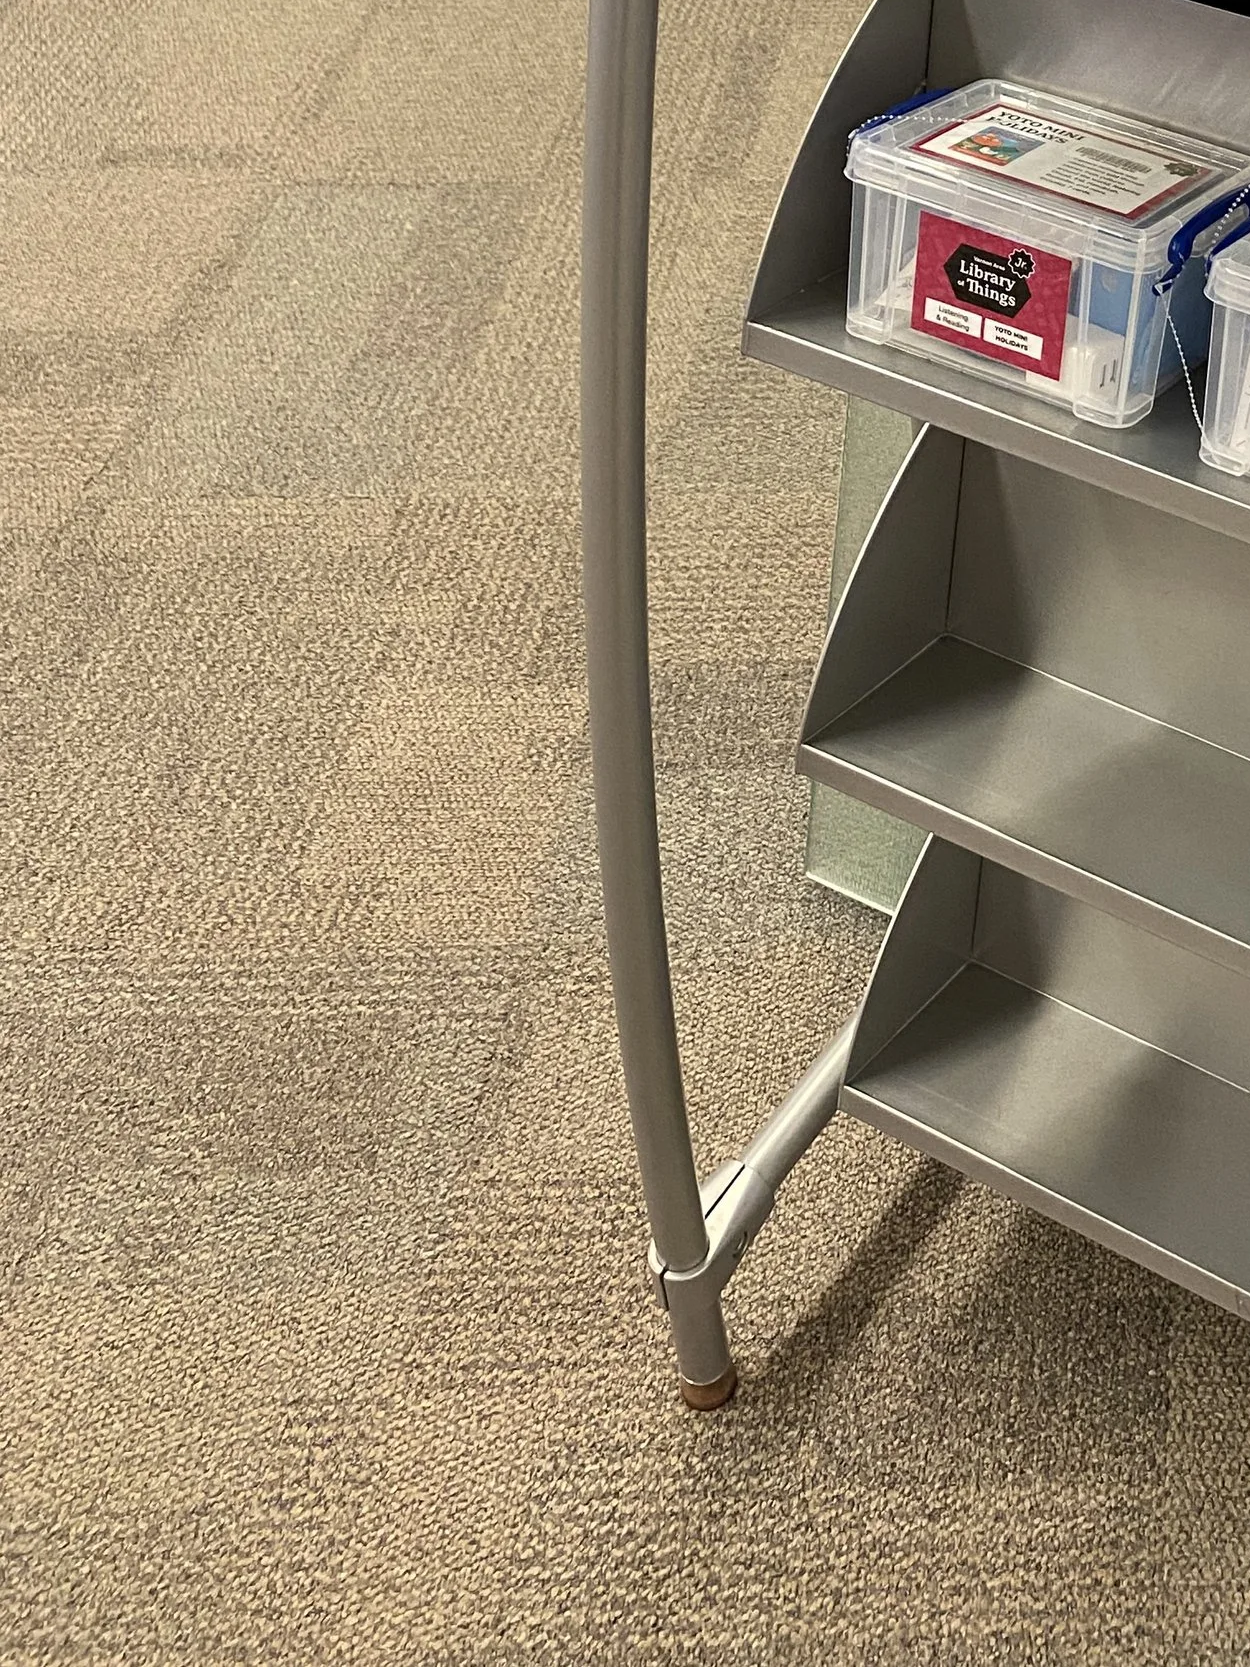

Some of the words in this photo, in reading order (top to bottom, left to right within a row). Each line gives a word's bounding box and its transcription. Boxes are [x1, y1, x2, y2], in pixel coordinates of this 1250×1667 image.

[998, 111, 1044, 129] YOTO
[1044, 123, 1086, 142] MINI
[959, 259, 1016, 292] Library
[966, 278, 1016, 307] Things
[938, 305, 969, 323] Listening
[942, 316, 970, 332] Reading
[994, 325, 1012, 336] YOTO
[1013, 331, 1028, 342] MINI
[995, 335, 1028, 351] HOLIDAYS
